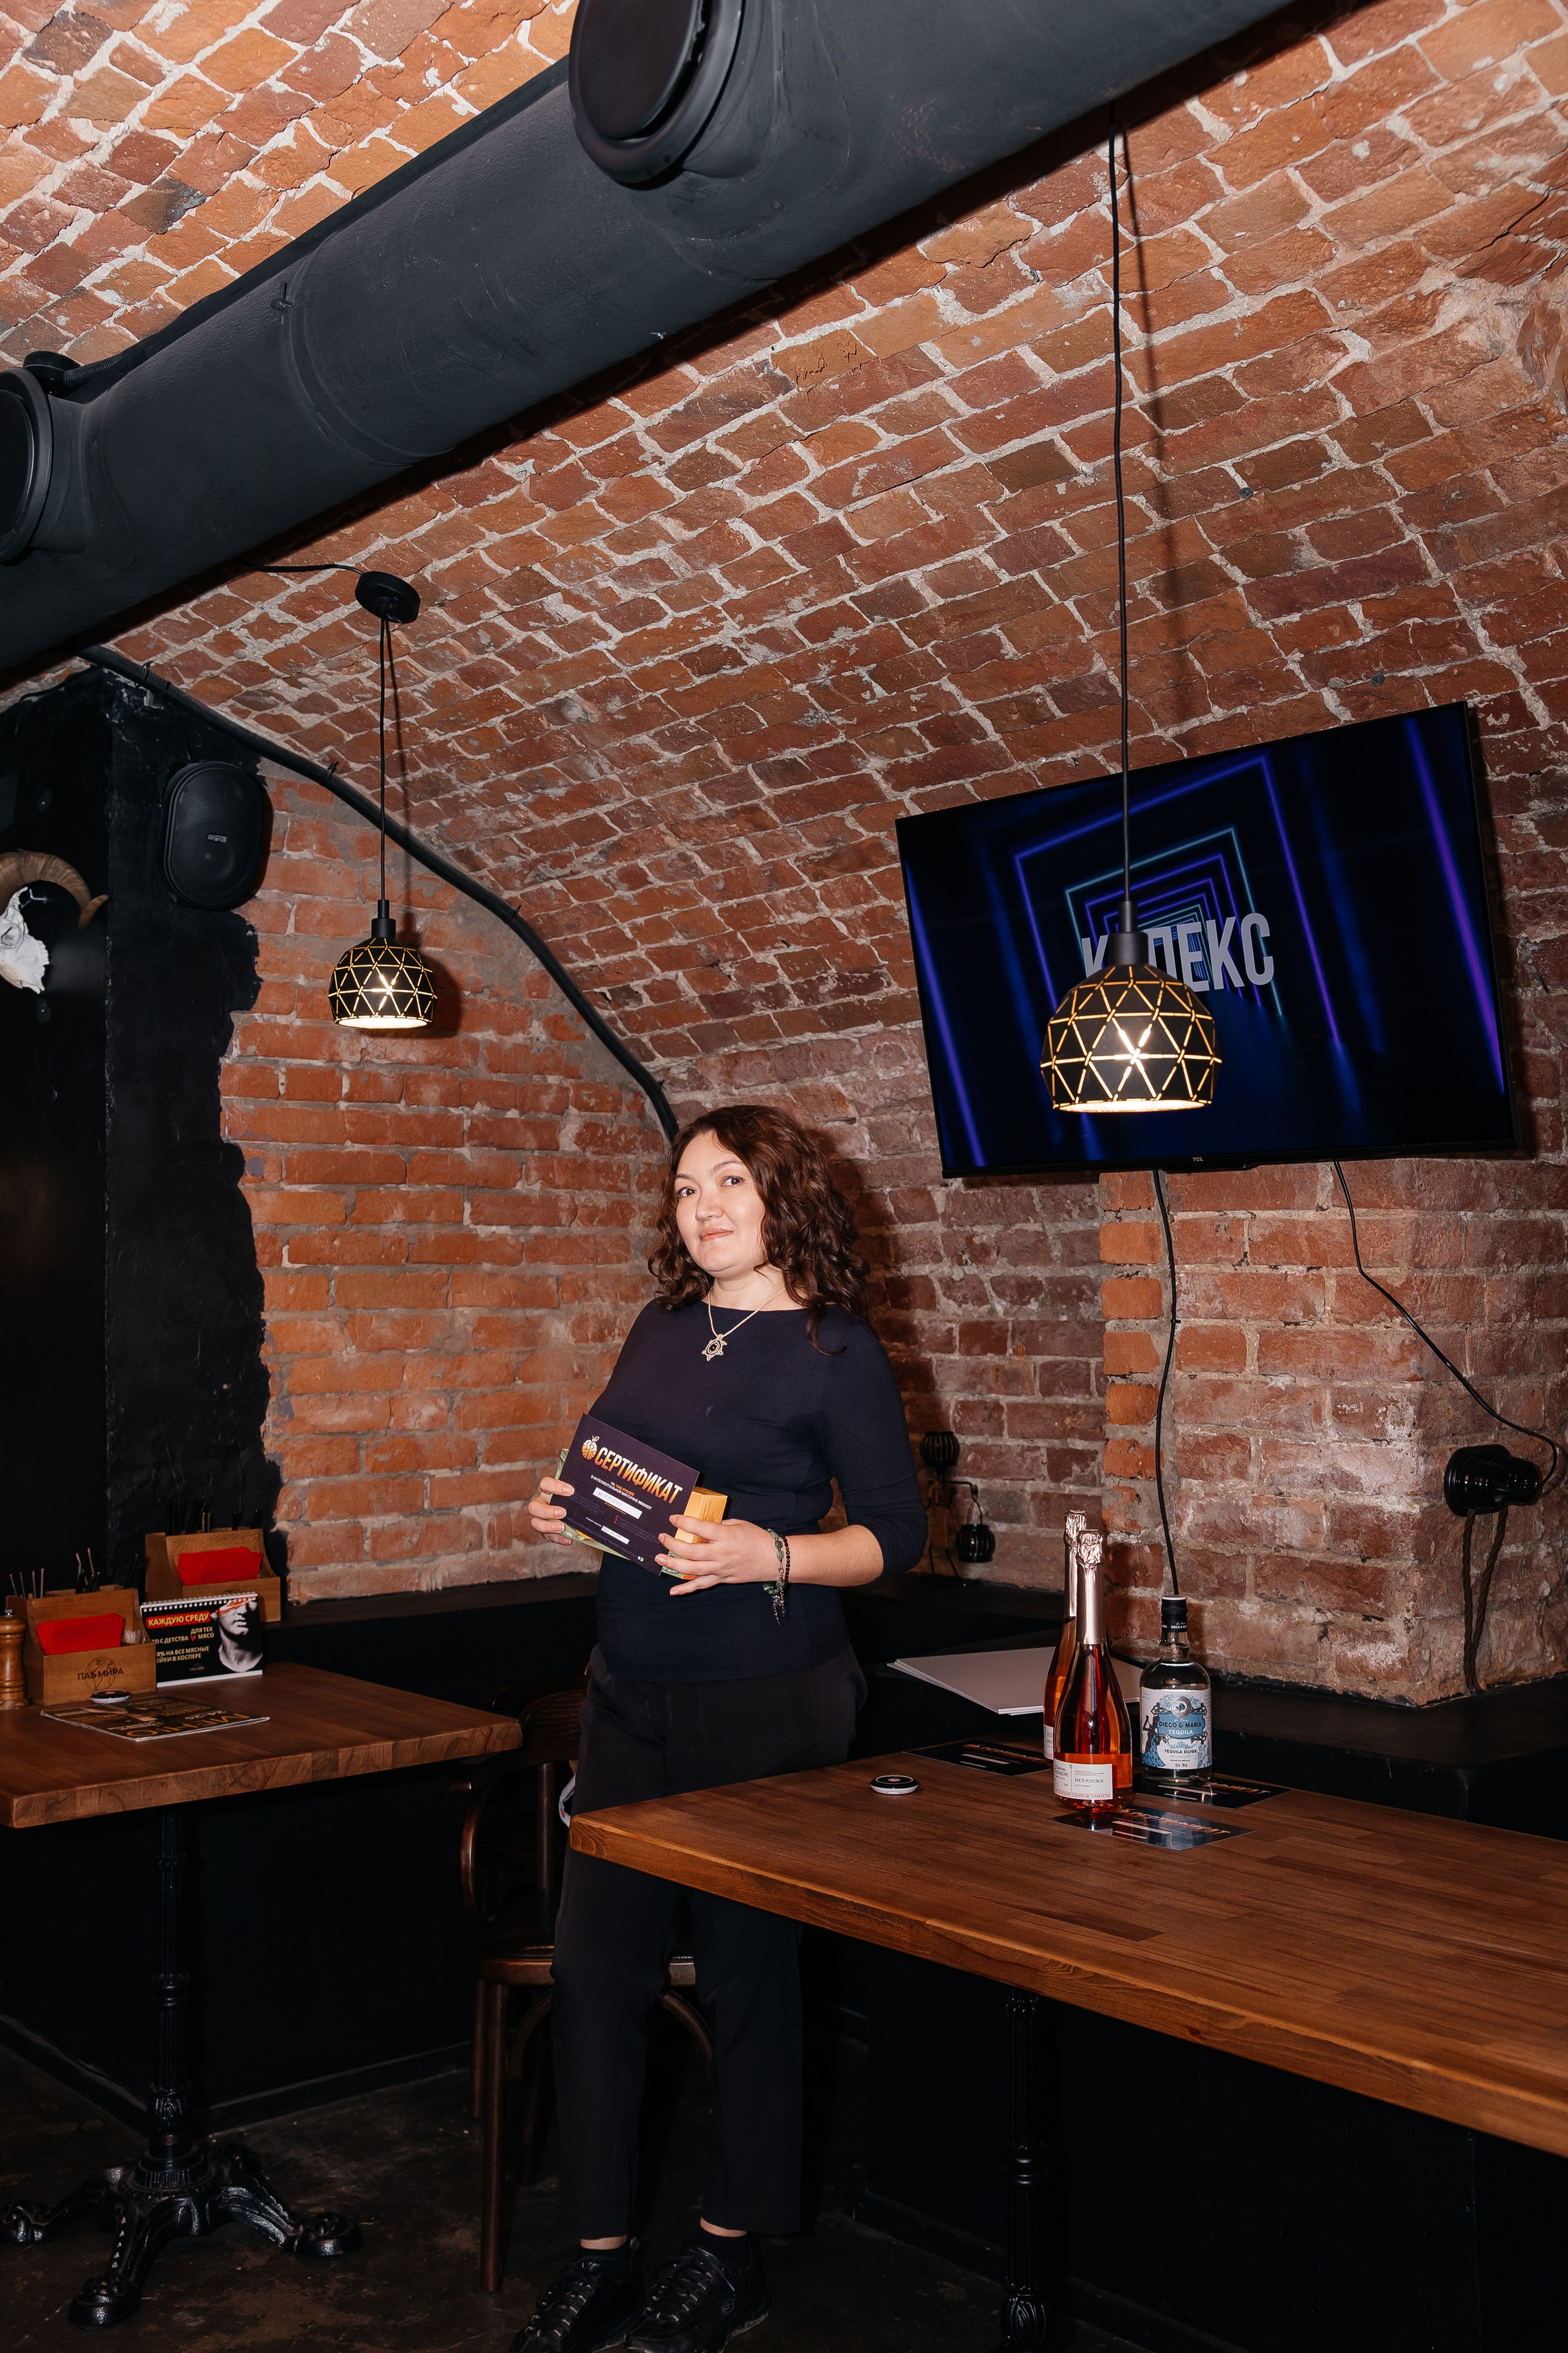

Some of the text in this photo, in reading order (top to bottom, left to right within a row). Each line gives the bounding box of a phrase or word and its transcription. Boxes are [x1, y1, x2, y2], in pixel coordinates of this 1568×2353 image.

[594, 1447, 684, 1504] СЕРТИФИКАТ
[149, 1613, 209, 1626] КАЖДУЮ СРЕДУ
[164, 1636, 189, 1644] ДЕТСТВА
[77, 1667, 124, 1680] ПАБ МИРА
